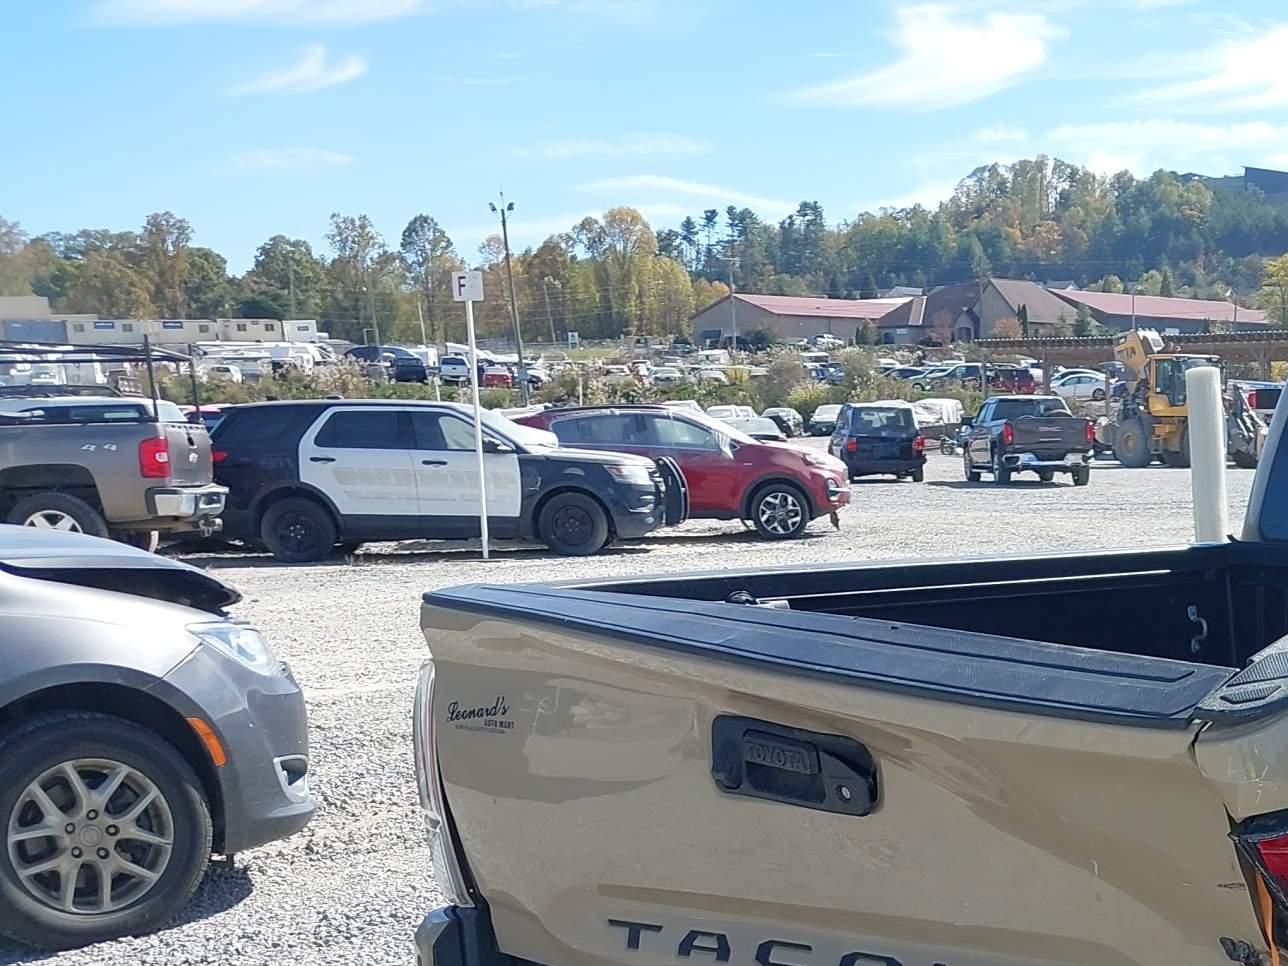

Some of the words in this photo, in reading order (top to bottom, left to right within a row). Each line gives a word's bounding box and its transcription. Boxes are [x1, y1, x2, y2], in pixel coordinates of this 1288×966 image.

[458, 276, 466, 296] F
[447, 696, 509, 722] Leonard's
[747, 743, 807, 771] TOYOTA
